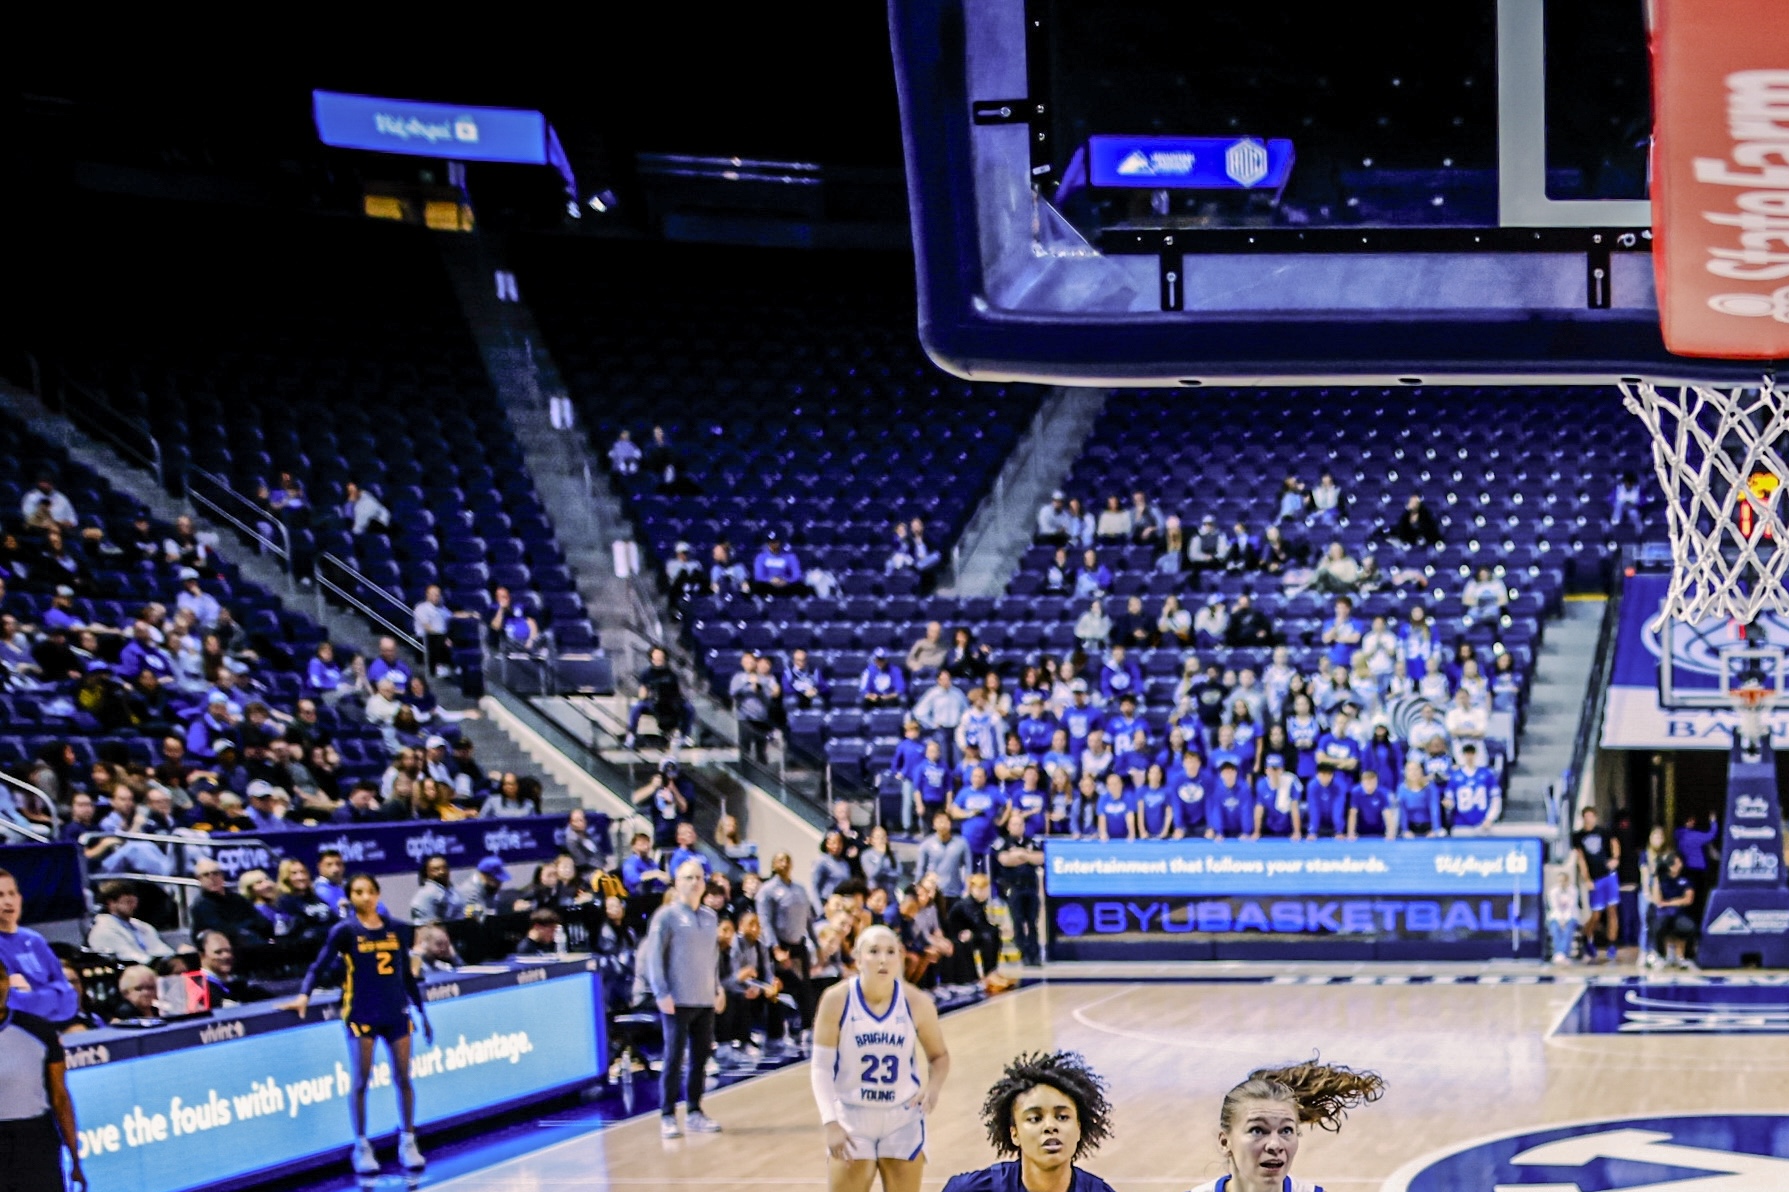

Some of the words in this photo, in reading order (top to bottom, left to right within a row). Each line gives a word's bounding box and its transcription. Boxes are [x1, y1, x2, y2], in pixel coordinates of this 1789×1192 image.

[1053, 856, 1166, 874] Entertainment
[1170, 856, 1203, 873] that
[1206, 855, 1264, 873] follows
[1267, 859, 1302, 877] your
[1305, 856, 1389, 873] standards.
[376, 951, 394, 975] 2
[855, 1031, 905, 1048] BRIGHAM
[860, 1054, 899, 1084] 23
[123, 1105, 168, 1148] the
[170, 1089, 231, 1136] fouls
[233, 1076, 285, 1121] with
[286, 1074, 335, 1119] your
[335, 1061, 390, 1097] he
[445, 1031, 533, 1070] advantage.
[860, 1088, 896, 1102] YOUNG
